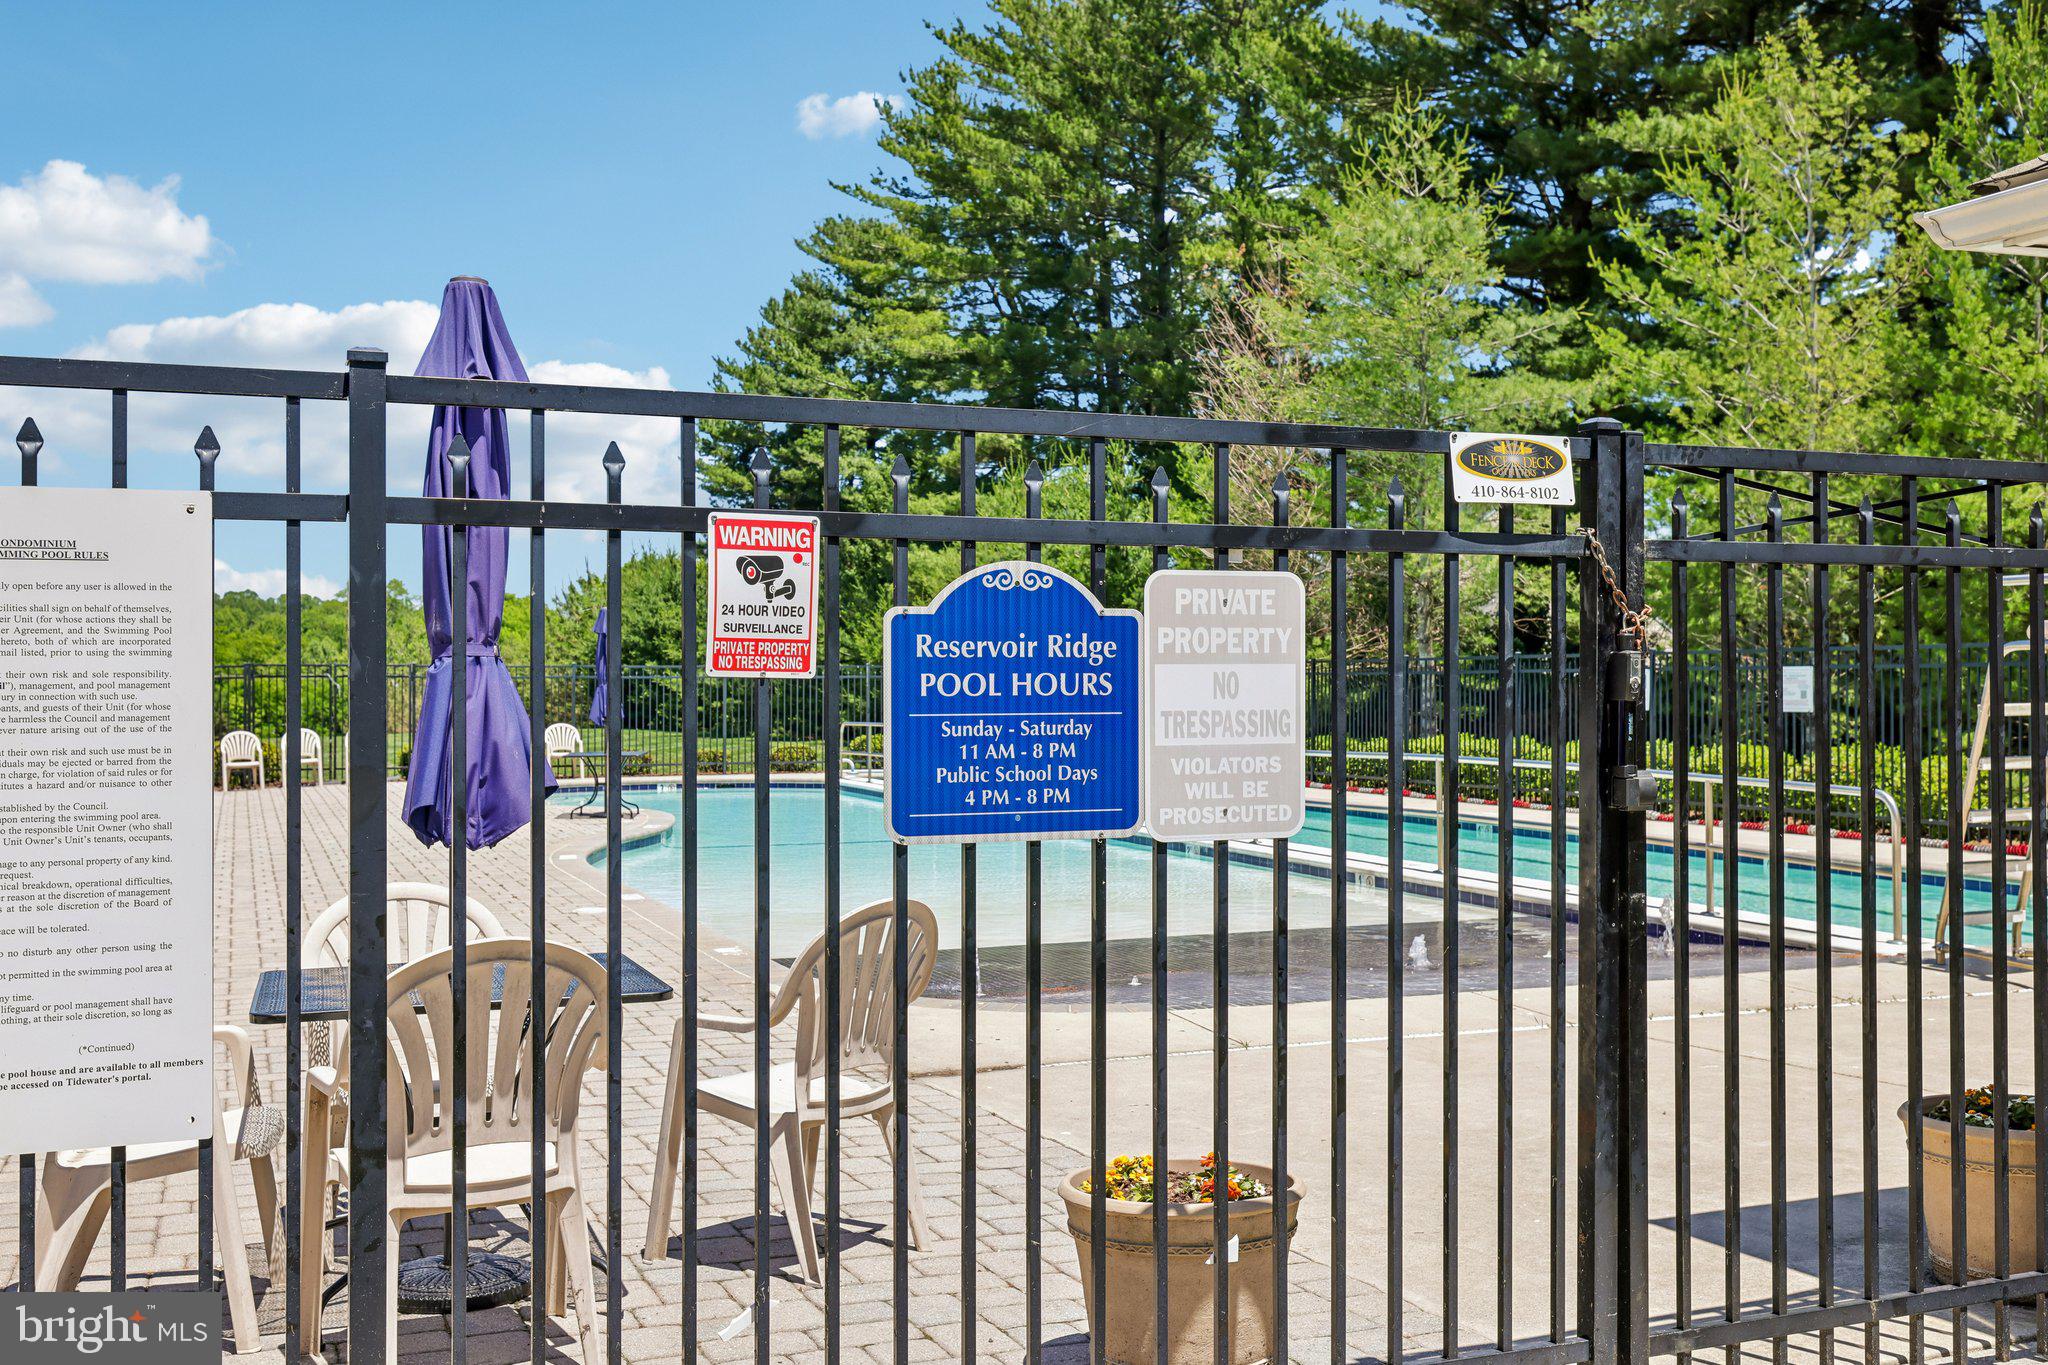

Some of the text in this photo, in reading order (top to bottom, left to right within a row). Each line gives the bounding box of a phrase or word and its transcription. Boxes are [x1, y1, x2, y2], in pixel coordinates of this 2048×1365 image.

[1523, 456, 1555, 469] DECK
[1472, 486, 1560, 500] 410-864-8102
[719, 525, 810, 548] WARNING
[41, 551, 72, 559] POOL
[74, 551, 109, 560] RULES
[12, 584, 34, 592] open
[36, 582, 63, 590] before
[65, 584, 81, 592] any
[104, 582, 111, 590] is
[113, 582, 147, 590] allowed
[149, 583, 157, 591] in
[159, 583, 172, 591] the
[29, 604, 50, 612] shall
[51, 604, 70, 614] sign
[84, 604, 110, 612] behalf
[112, 604, 121, 612] of
[123, 604, 172, 614] themselves,
[1175, 588, 1276, 616] PRIVATE
[722, 604, 805, 618] 24 HOUR VIDEO
[14, 615, 172, 625] Unit (for whose actions they shall be
[14, 626, 172, 636] Agreement, and the Swimming Pool
[724, 622, 802, 634] SURVEILLANCE
[34, 637, 54, 645] both
[58, 637, 67, 645] of
[72, 637, 98, 645] which
[119, 637, 172, 647] incorporated
[1158, 626, 1292, 654] PROPERTY
[21, 648, 172, 658] listed, prior to using the swimming
[714, 640, 810, 656] PRIVATE PROPERTY
[916, 633, 1118, 666] Reservoir Ridge
[718, 656, 802, 670] NO TRESPASSING
[5, 670, 25, 678] their
[52, 670, 68, 678] risk
[72, 670, 88, 678] and
[92, 670, 109, 678] sole
[113, 670, 172, 680] responsibility.
[19, 681, 171, 692] management, and pool management
[920, 672, 1113, 698] POOL HOURS
[1212, 671, 1239, 700] NO
[18, 693, 27, 701] in
[28, 692, 76, 701] connection
[78, 692, 97, 700] with
[99, 692, 119, 700] such
[941, 720, 1003, 740] Sunday
[1020, 720, 1093, 740] Saturday
[1161, 710, 1292, 739] TRESPASSING
[960, 744, 978, 760] 11
[985, 744, 1015, 760] AM
[1032, 743, 1042, 758] 8
[1049, 743, 1076, 758] PM
[1170, 756, 1282, 776] VIOLATORS
[8, 770, 40, 781] charge,
[42, 770, 54, 778] for
[57, 769, 95, 778] violation
[96, 769, 105, 777] of
[108, 769, 125, 777] said
[126, 768, 148, 776] rules
[160, 768, 172, 776] for
[936, 764, 1098, 786] Public School Days
[964, 789, 975, 806] 4
[981, 789, 1010, 806] PM
[1026, 788, 1038, 804] 8
[1044, 788, 1070, 804] PM
[1185, 780, 1268, 800] WILL BE
[44, 802, 109, 813] by the Council.
[20, 814, 56, 825] entering
[58, 814, 71, 822] the
[73, 813, 118, 823] swimming
[120, 812, 139, 822] pool
[1159, 804, 1292, 826] PROSECUTED
[3, 837, 22, 845] Unit
[94, 834, 126, 844] tenants,
[128, 833, 173, 844] occupants,
[19, 855, 172, 869] to any personal property of any kind.
[22, 877, 172, 890] breakdown, operational difficulties,
[18, 924, 90, 934] will be tolerated.
[1, 1003, 40, 1015] lifeguard
[53, 1001, 73, 1012] pool
[75, 999, 129, 1011] management
[131, 997, 151, 1006] shall
[153, 996, 173, 1005] have
[8, 1068, 28, 1080] pool
[30, 1066, 57, 1076] house
[59, 1065, 76, 1075] and
[96, 1061, 136, 1072] available
[138, 1060, 148, 1070] to
[150, 1060, 161, 1069] all
[163, 1057, 204, 1068] members
[10, 1079, 50, 1089] accessed
[121, 1072, 152, 1085] portal.
